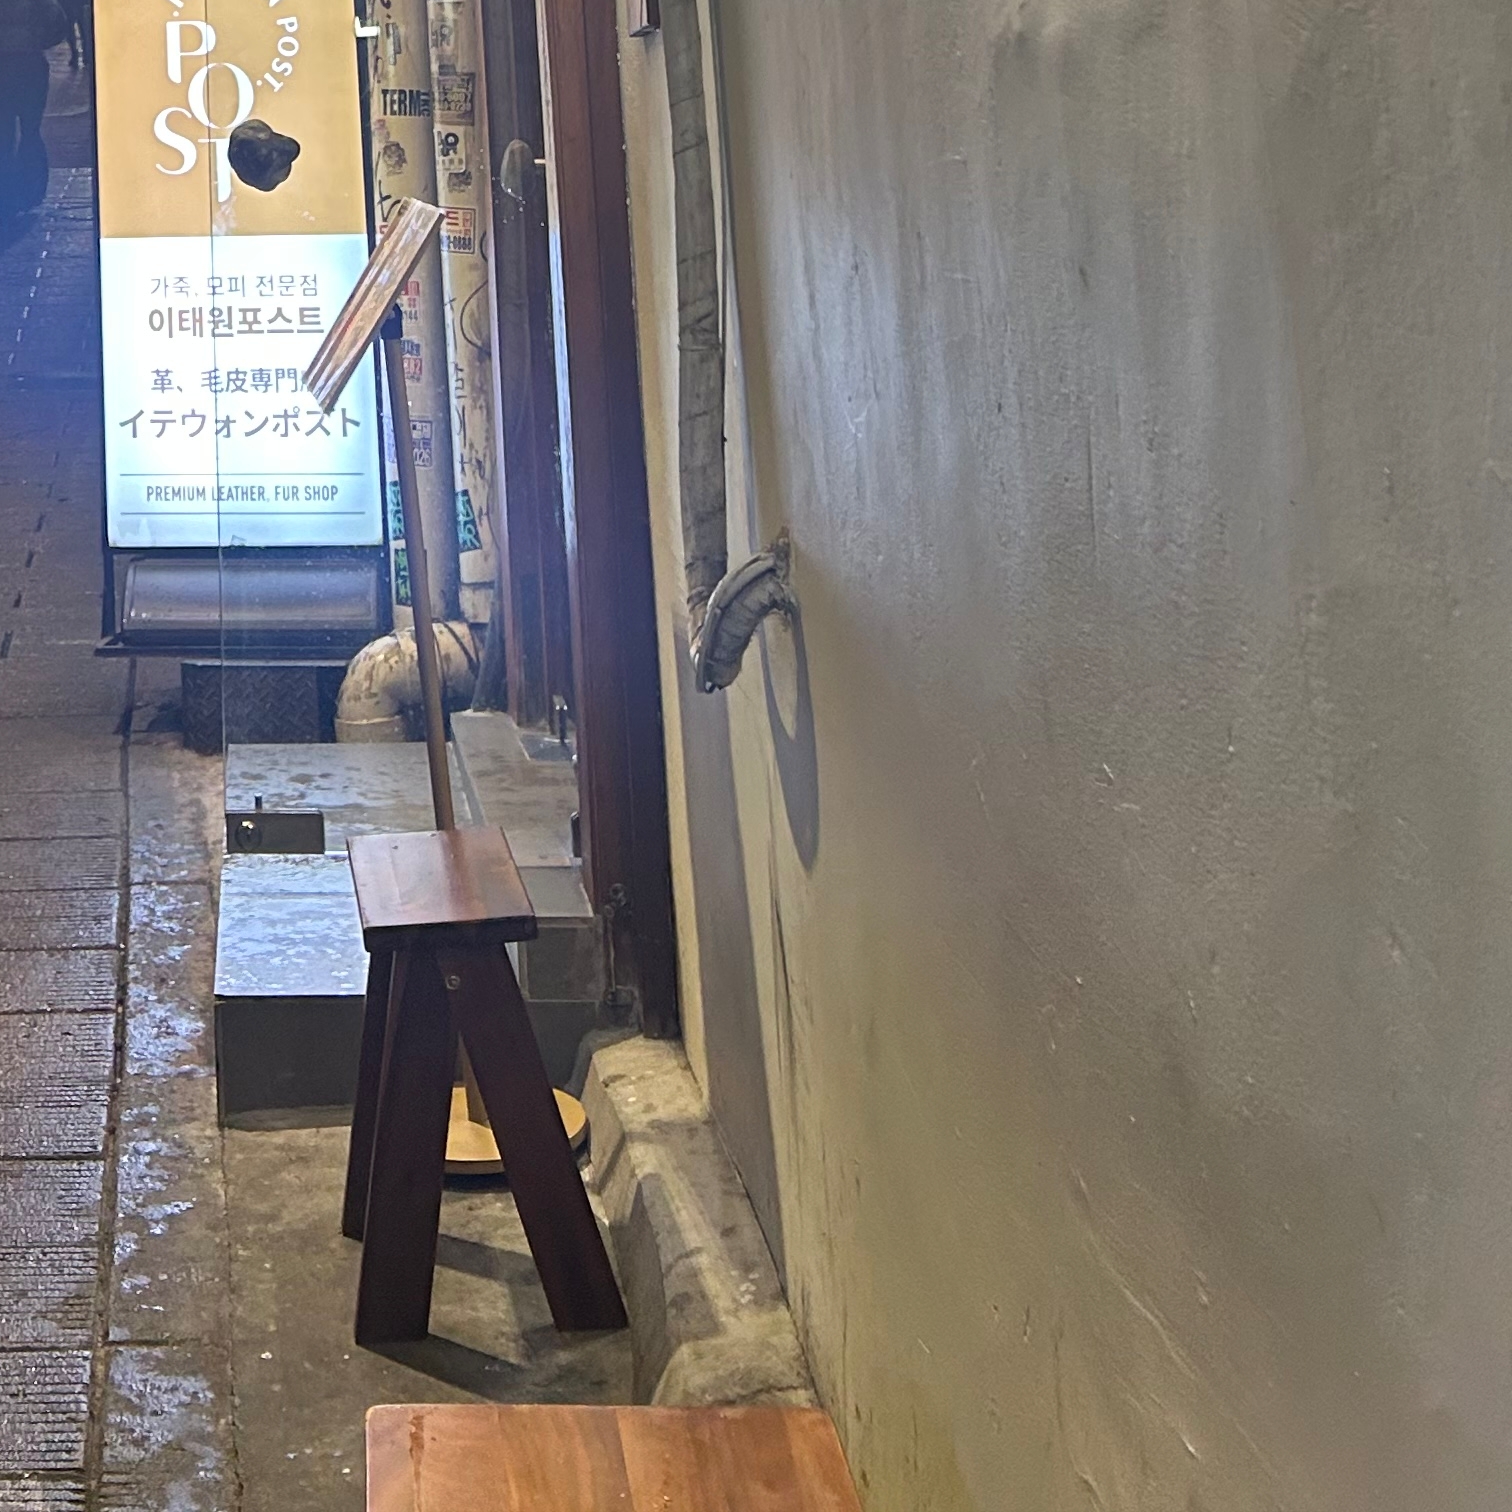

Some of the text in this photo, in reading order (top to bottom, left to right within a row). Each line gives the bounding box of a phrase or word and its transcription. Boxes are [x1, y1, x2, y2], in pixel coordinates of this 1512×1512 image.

[255, 274, 318, 297] 전문점
[148, 305, 325, 338] 이태원포스트
[146, 485, 207, 502] PREMIUM
[274, 485, 299, 501] FUR
[304, 485, 339, 501] SHOP
